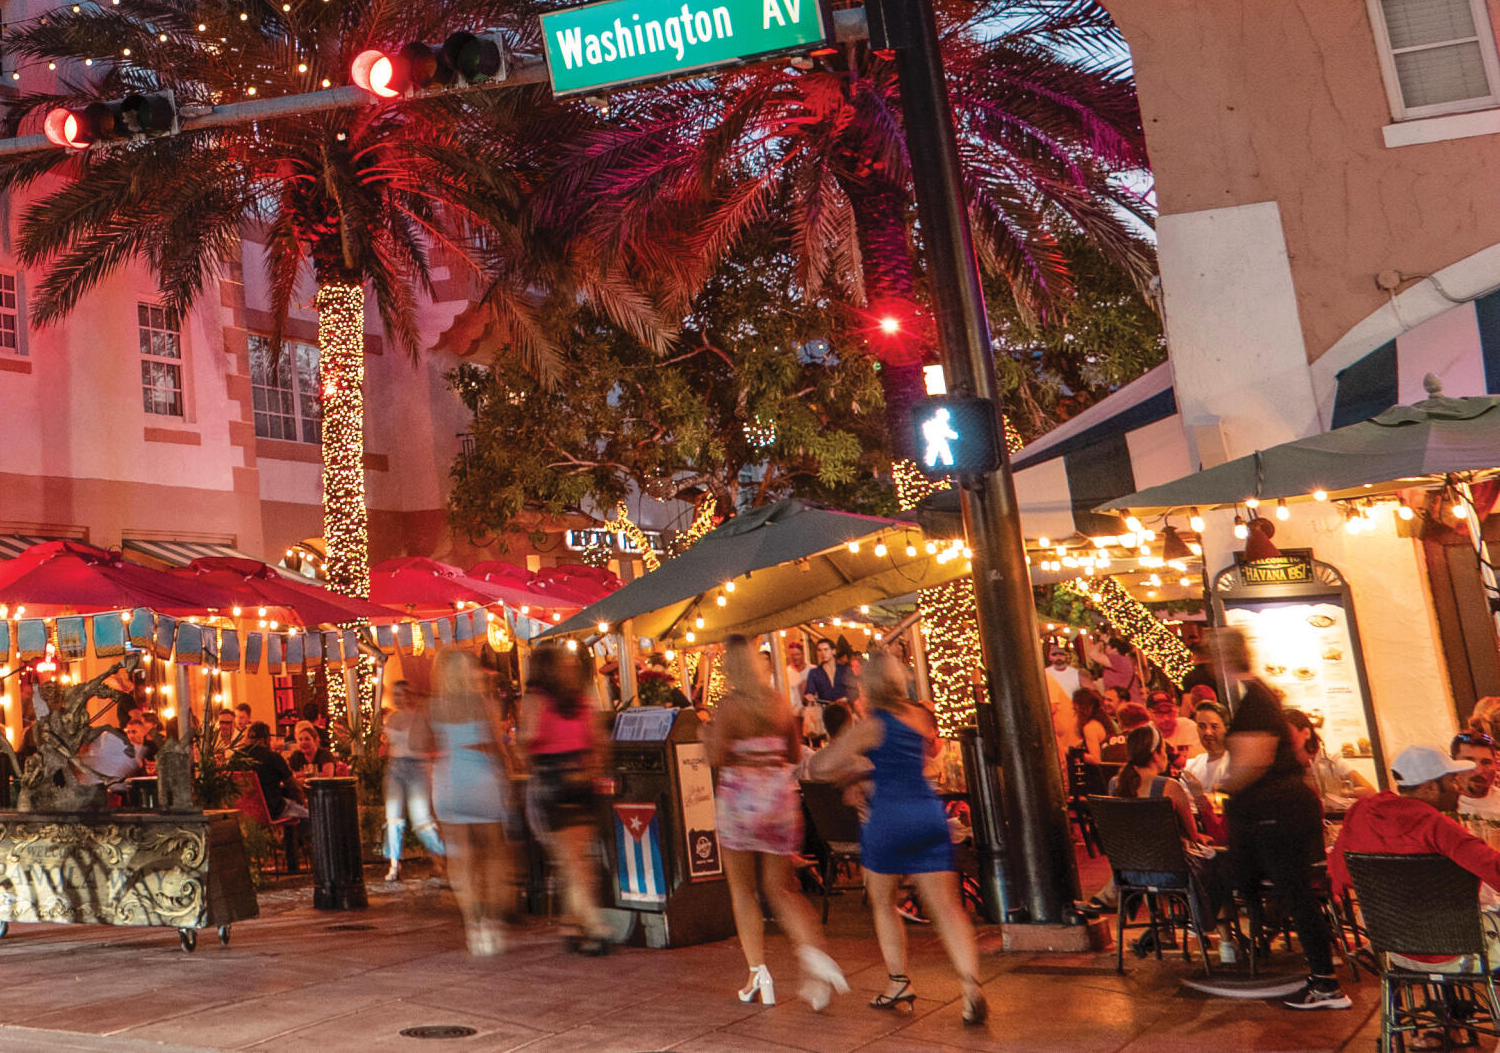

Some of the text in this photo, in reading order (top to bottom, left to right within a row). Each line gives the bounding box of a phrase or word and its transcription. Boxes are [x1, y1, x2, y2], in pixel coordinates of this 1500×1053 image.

[556, 3, 733, 69] Washington
[1249, 556, 1288, 565] ELCOME
[1245, 566, 1287, 582] HAVANA
